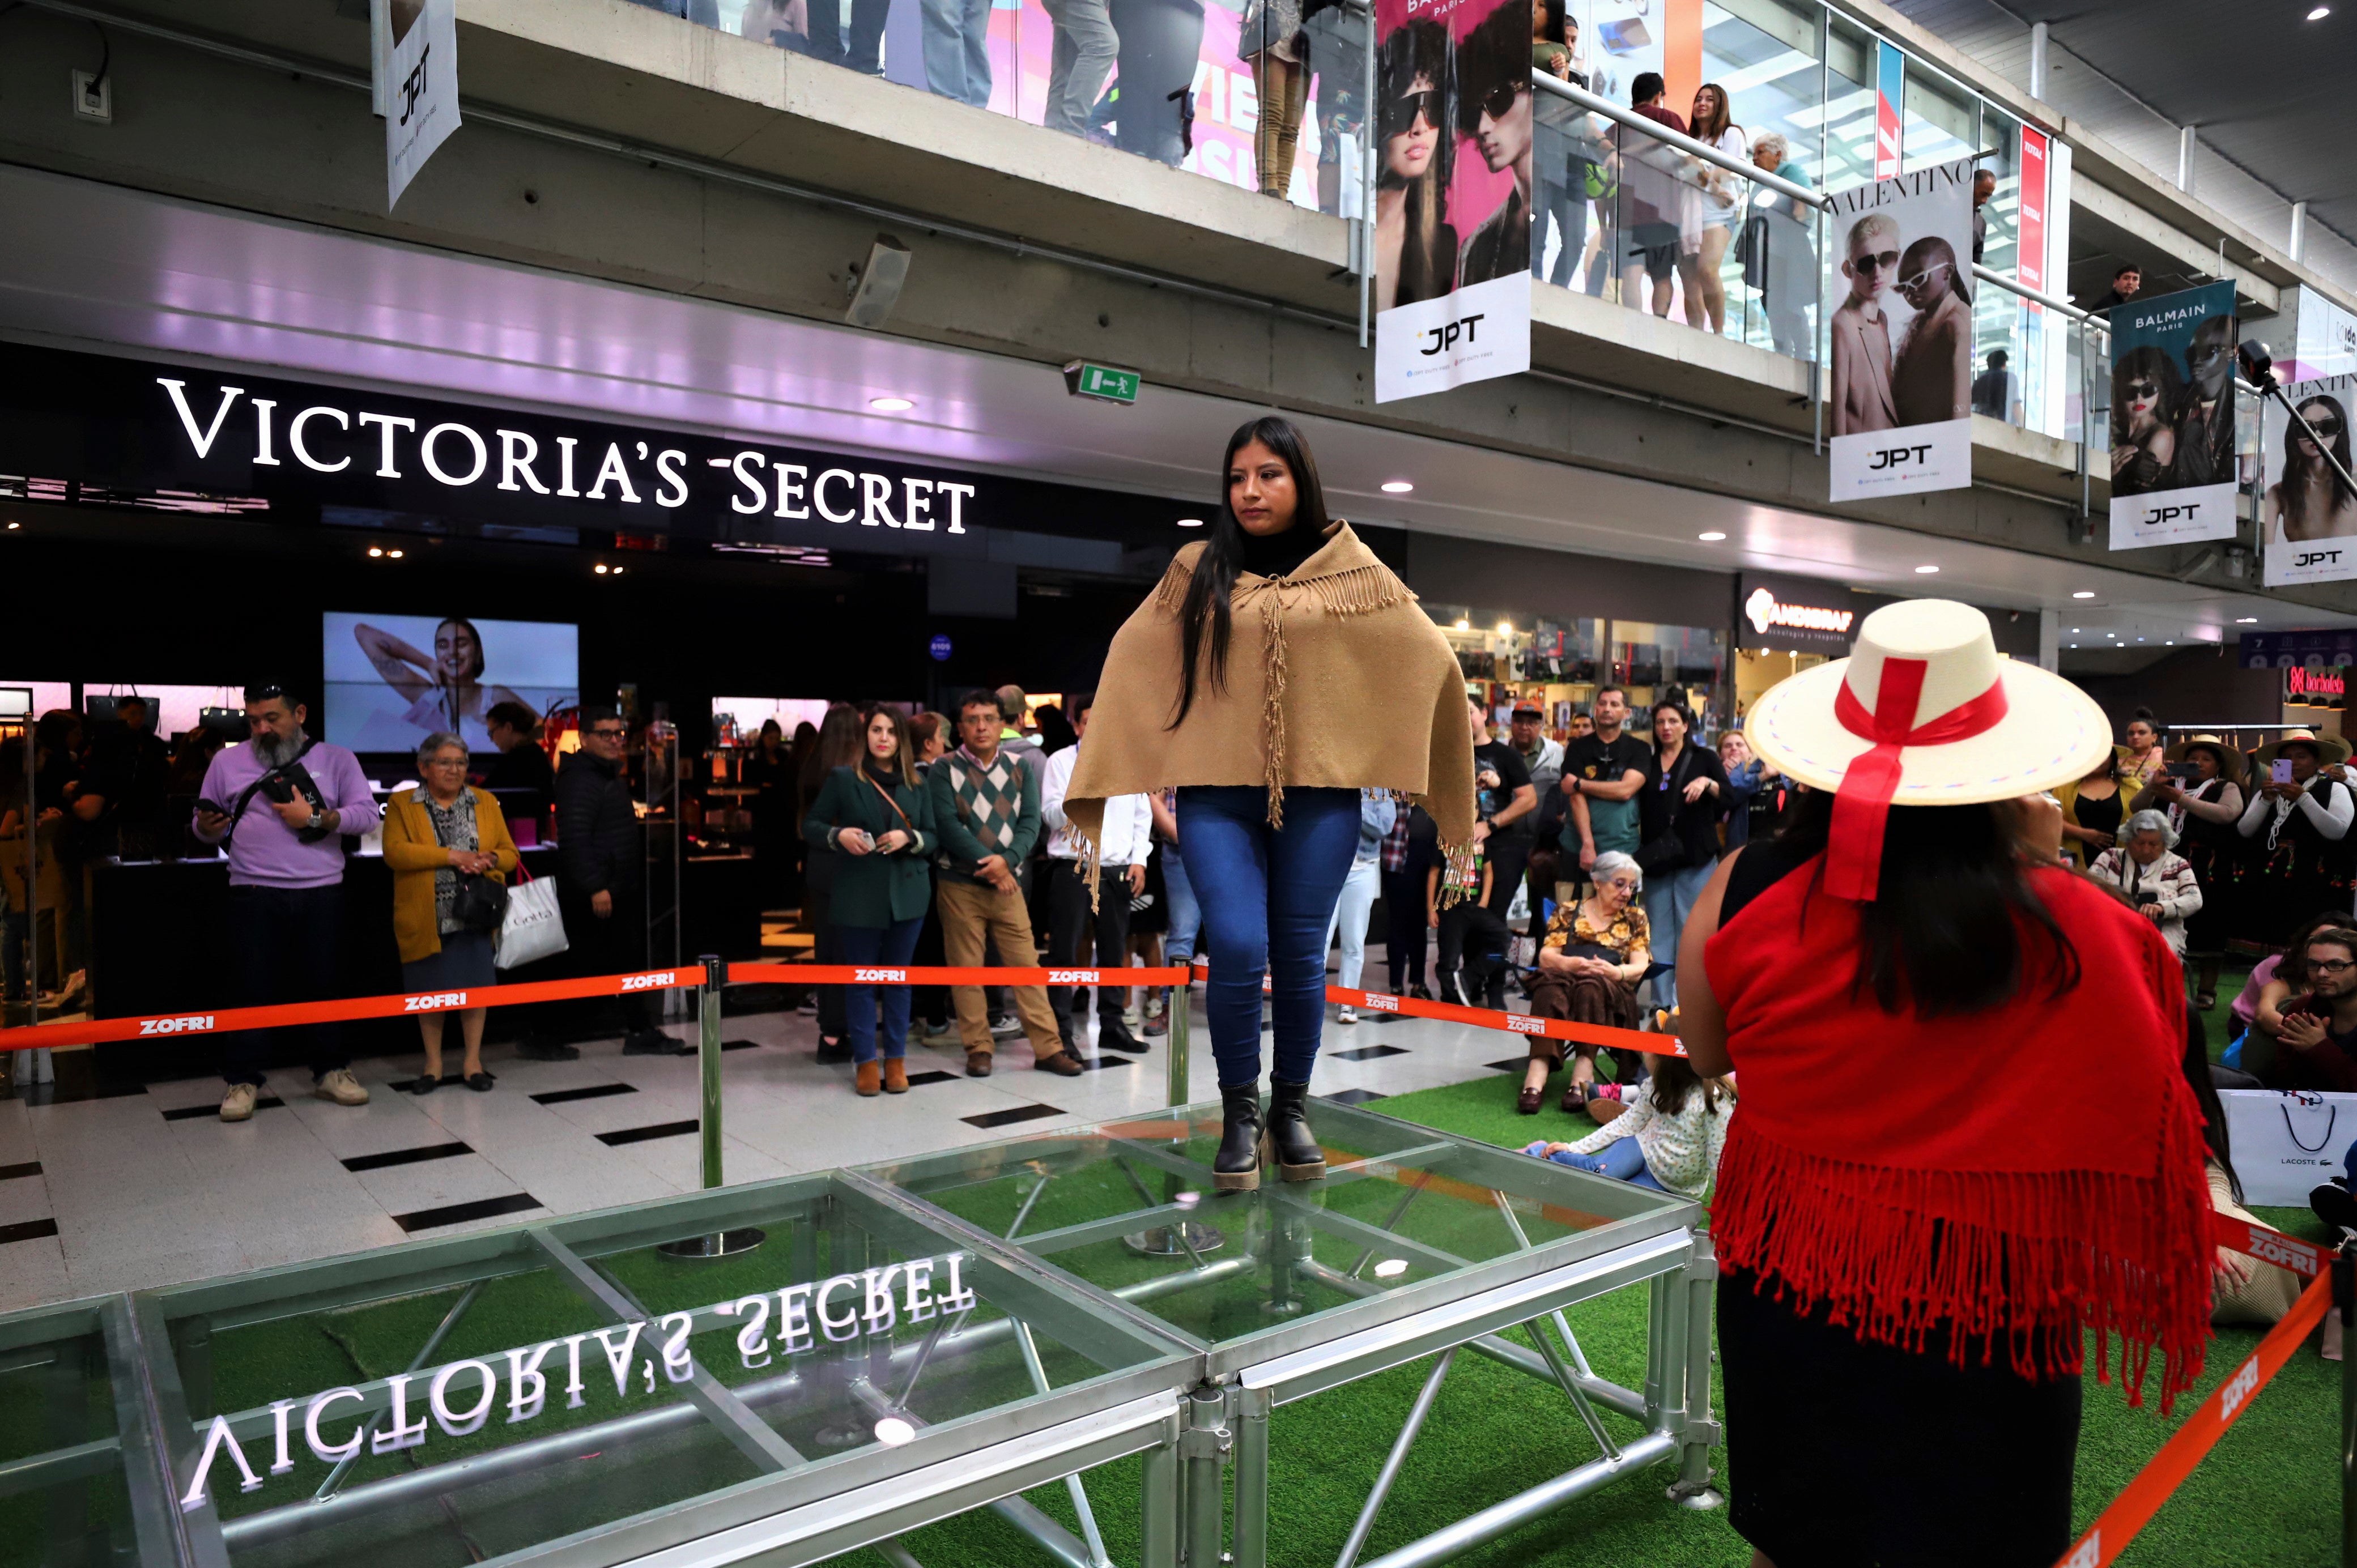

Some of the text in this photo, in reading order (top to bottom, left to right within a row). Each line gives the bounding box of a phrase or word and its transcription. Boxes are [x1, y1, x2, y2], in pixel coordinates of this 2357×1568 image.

[401, 42, 429, 126] JPT
[2024, 140, 2043, 160] TOTAL
[1828, 158, 1973, 217] VALENTINO
[2023, 204, 2041, 222] TOTAL
[2021, 264, 2039, 282] TOTAL
[2135, 304, 2205, 329] BALMAIN
[1420, 314, 1484, 355] JPT
[2157, 322, 2183, 333] PARIS
[2287, 373, 2357, 399] LENTIN
[1869, 445, 1932, 470] JPT
[731, 451, 975, 534] SECRET
[2145, 504, 2200, 525] JPT
[2295, 551, 2342, 566] JPT
[2307, 671, 2345, 694] borboleta
[622, 972, 675, 990] ZOFRI
[855, 969, 906, 982] ZOFRI
[1049, 971, 1100, 983] ZOFRI
[405, 992, 467, 1011] ZOFRI
[1366, 998, 1398, 1011] ZOFRI
[139, 1015, 214, 1035] ZOFRI
[1507, 1020, 1545, 1034] ZOFRI
[2249, 1236, 2317, 1276] ZOFRI
[2222, 1354, 2259, 1421] ZOFRI
